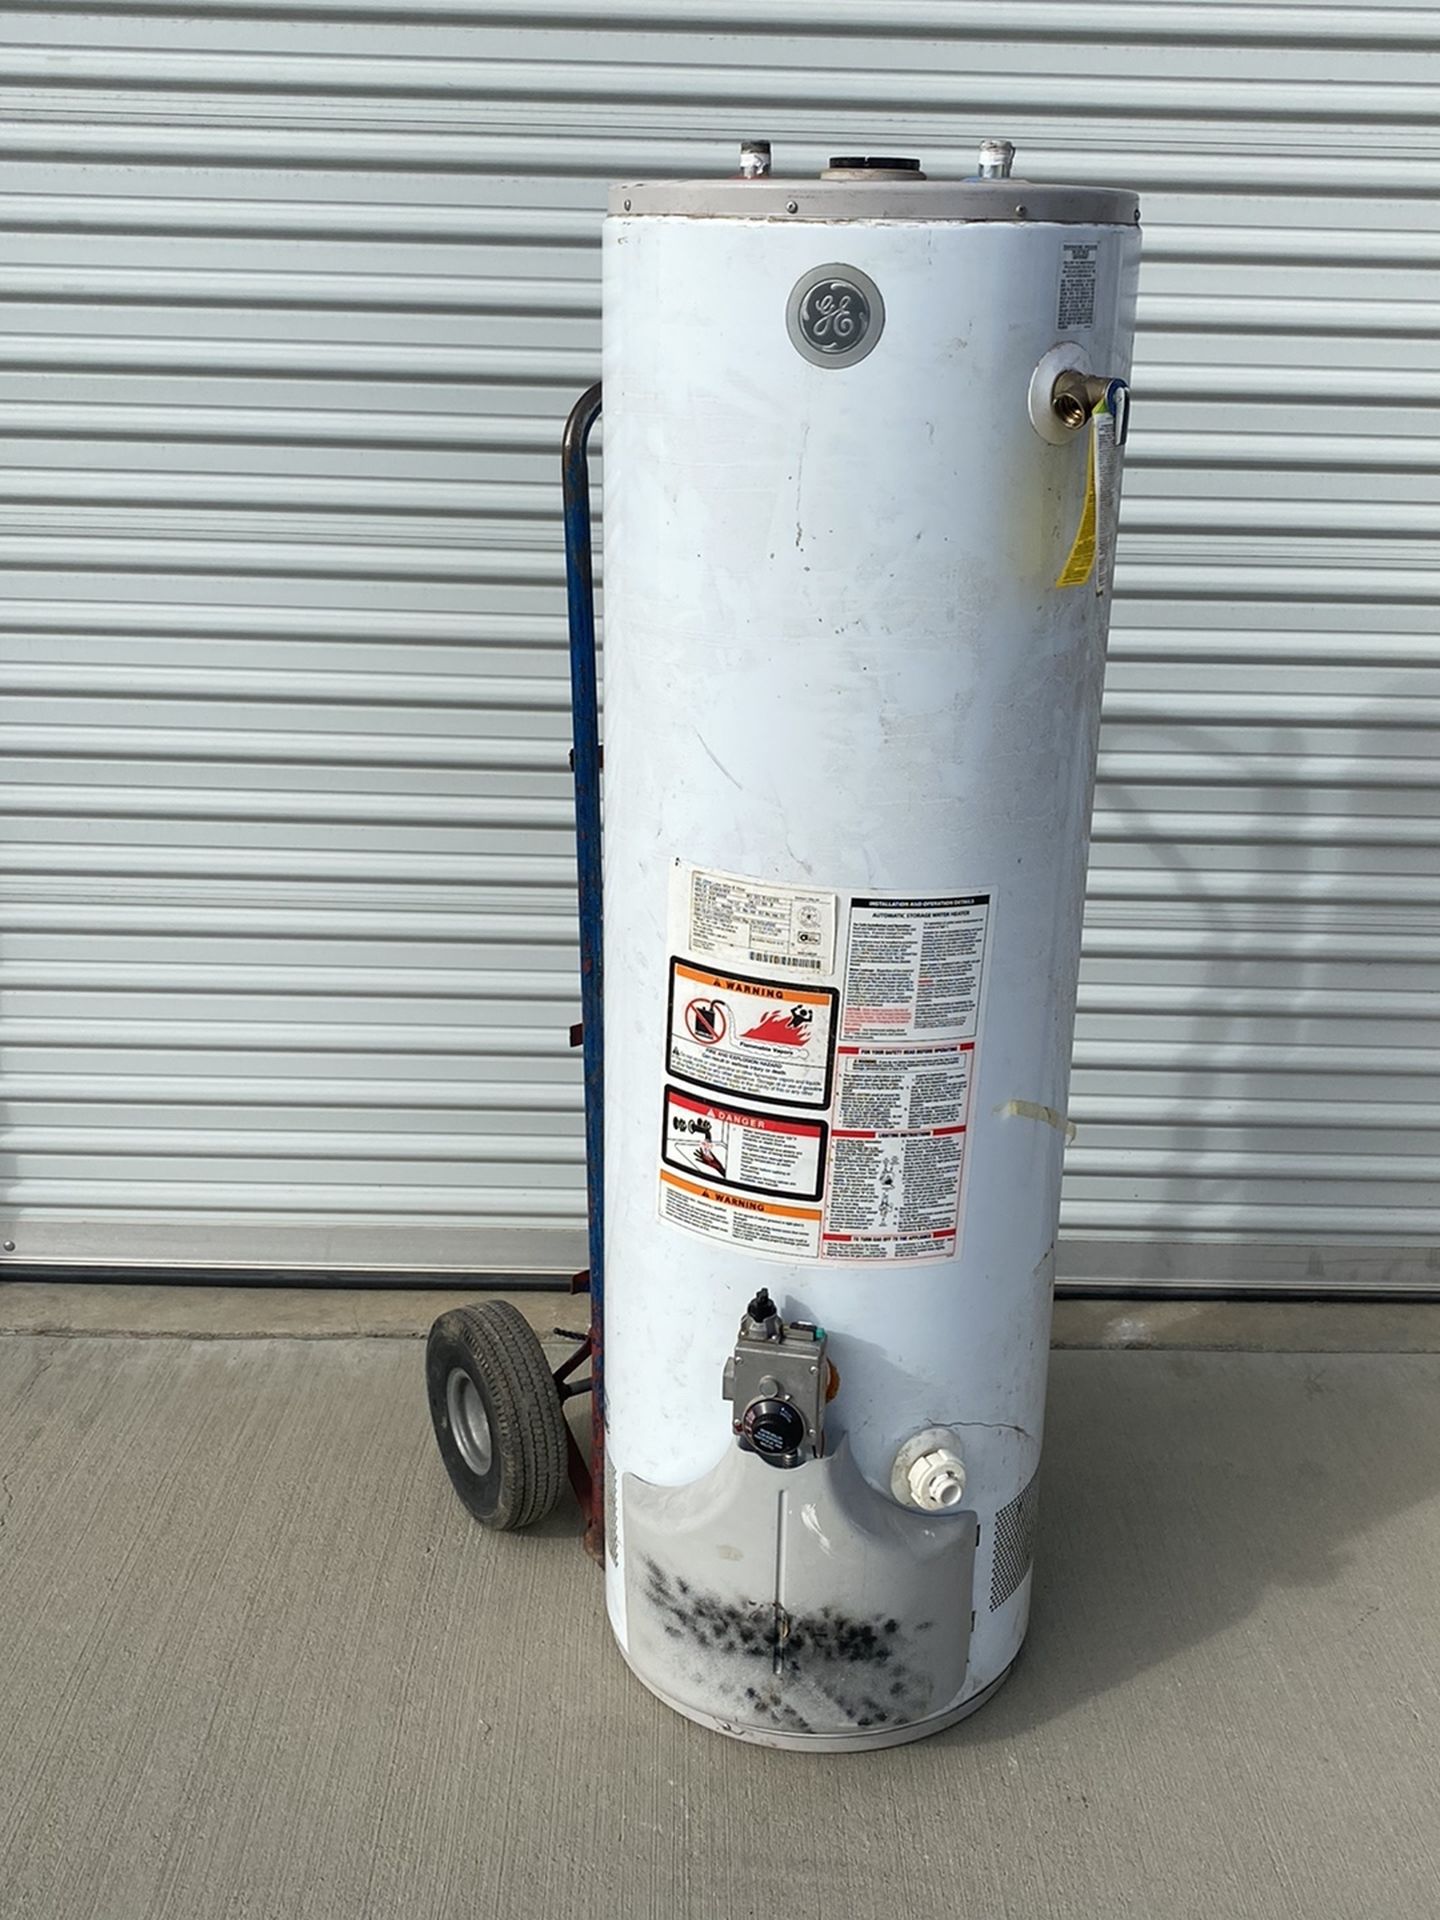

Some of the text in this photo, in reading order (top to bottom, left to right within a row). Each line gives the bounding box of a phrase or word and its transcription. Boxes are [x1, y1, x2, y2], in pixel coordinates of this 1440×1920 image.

[813, 294, 853, 336] GE
[726, 980, 784, 1000] WARNING
[740, 1041, 794, 1056] Flammable Vapors
[718, 1111, 766, 1129] DANGER
[715, 1192, 765, 1212] WARNING
